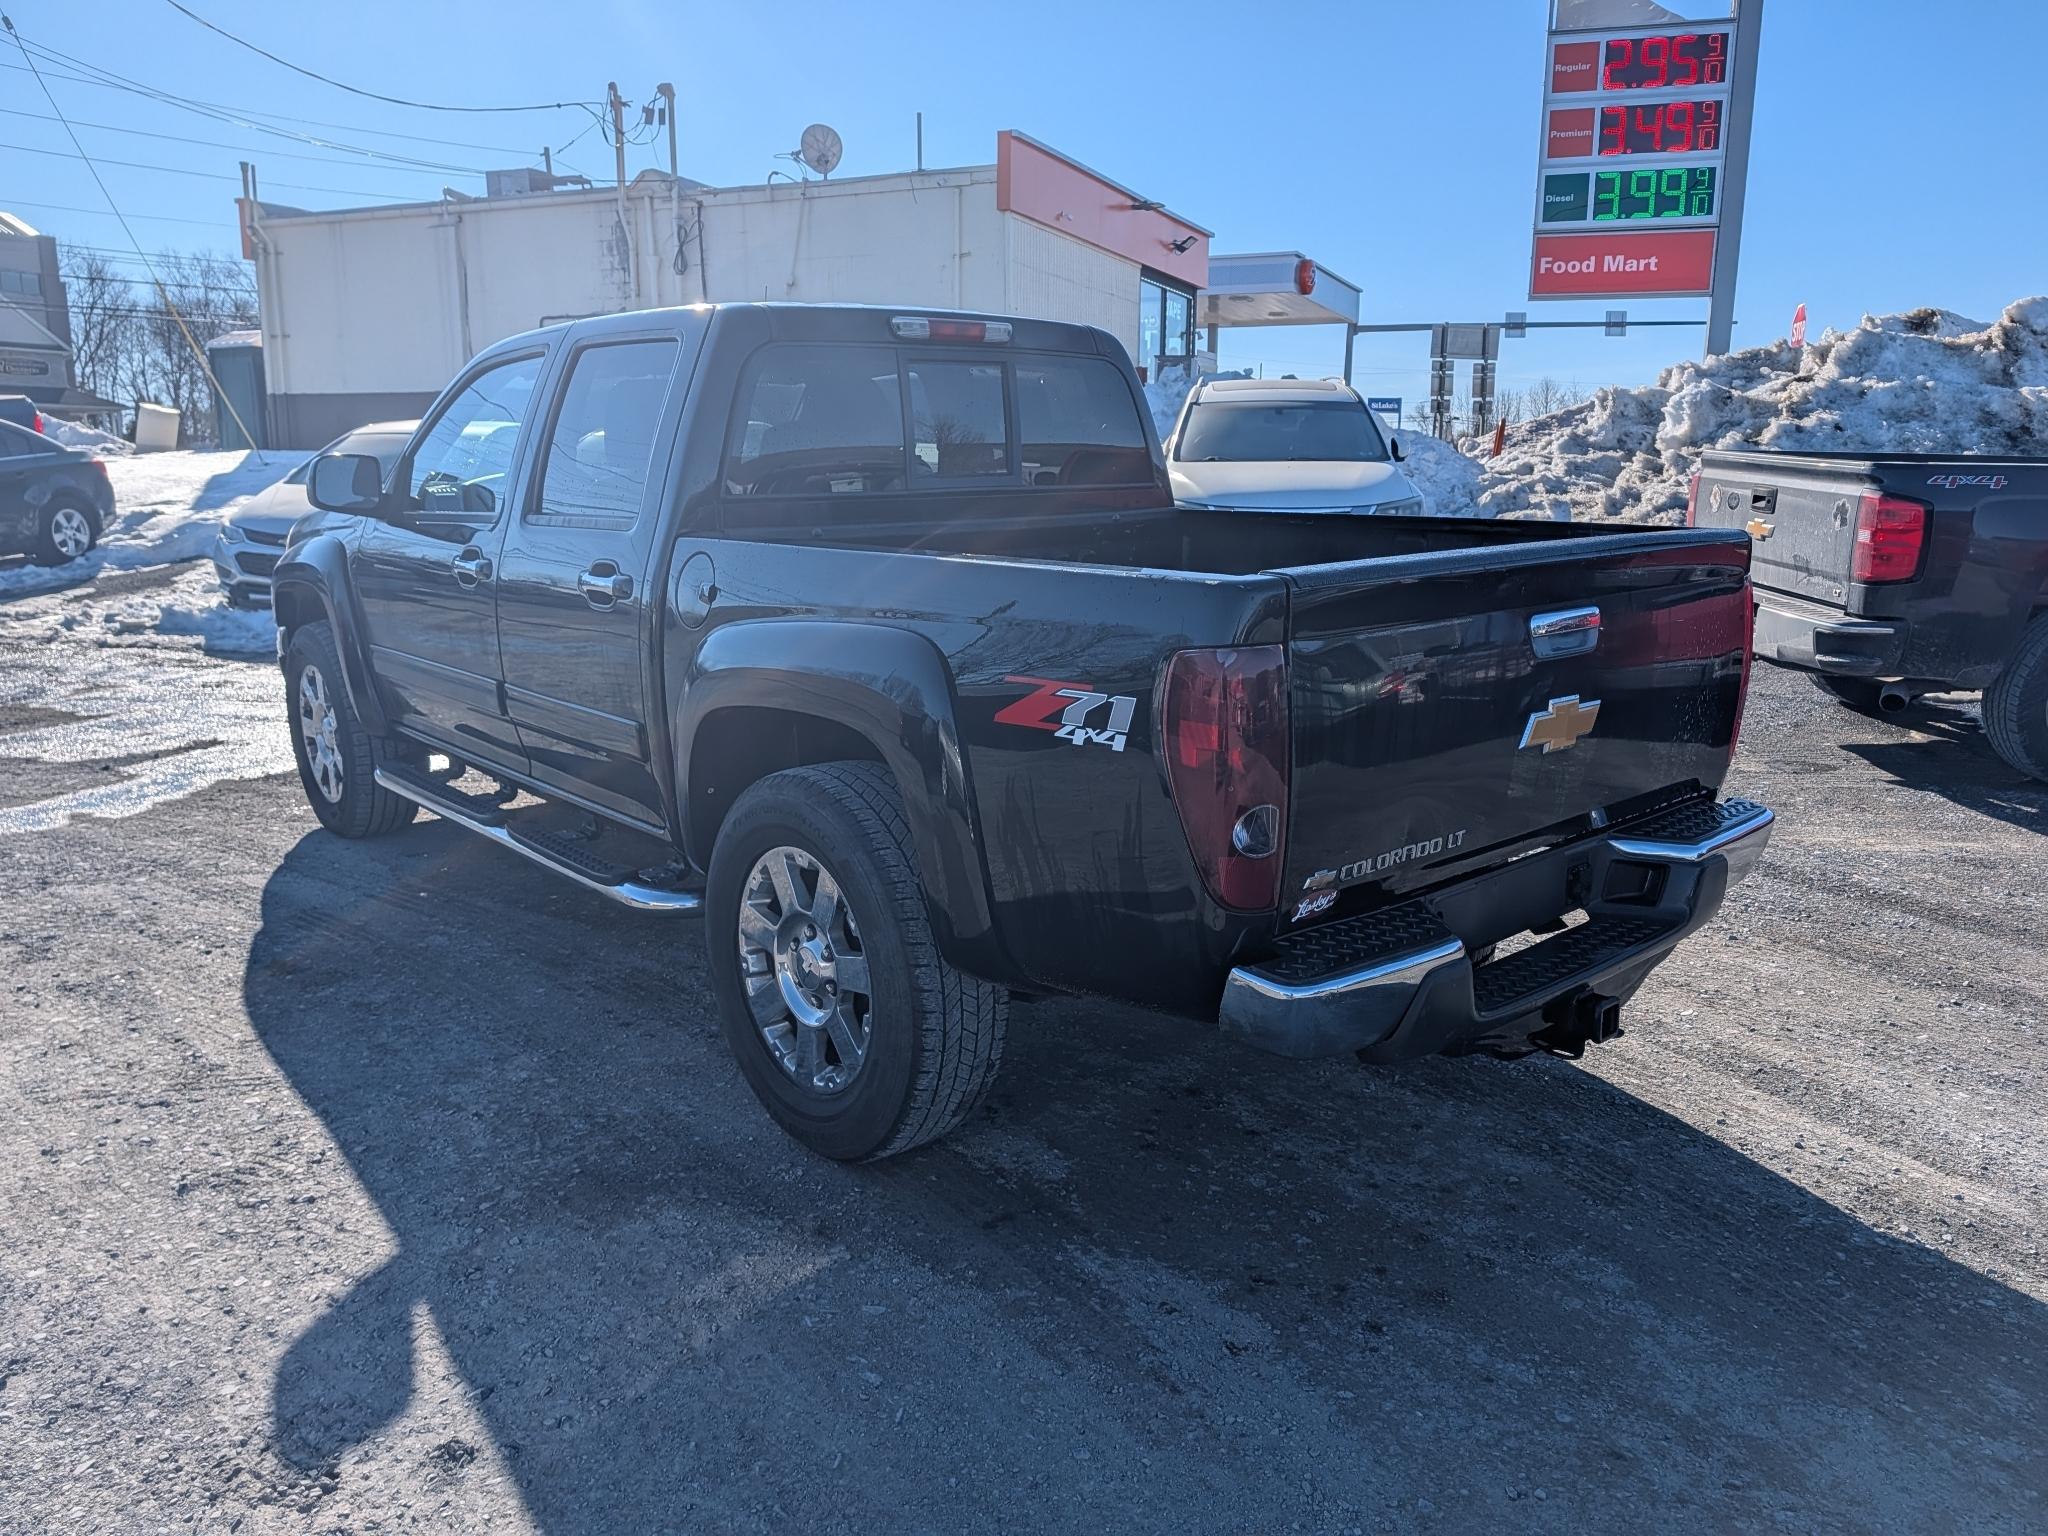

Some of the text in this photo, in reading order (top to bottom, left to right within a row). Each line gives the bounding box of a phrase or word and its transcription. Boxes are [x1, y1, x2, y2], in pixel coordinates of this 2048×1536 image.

[1555, 62, 1591, 73] Regular
[1602, 34, 1699, 90] 2.95
[1550, 129, 1592, 139] Premium
[1600, 101, 1695, 156] 3.49
[1545, 193, 1574, 203] Diesel
[1595, 168, 1688, 221] 3.99
[1540, 255, 1659, 274] Food Mart
[993, 675, 1137, 733] Z71
[1339, 829, 1466, 881] COLORADO LT
